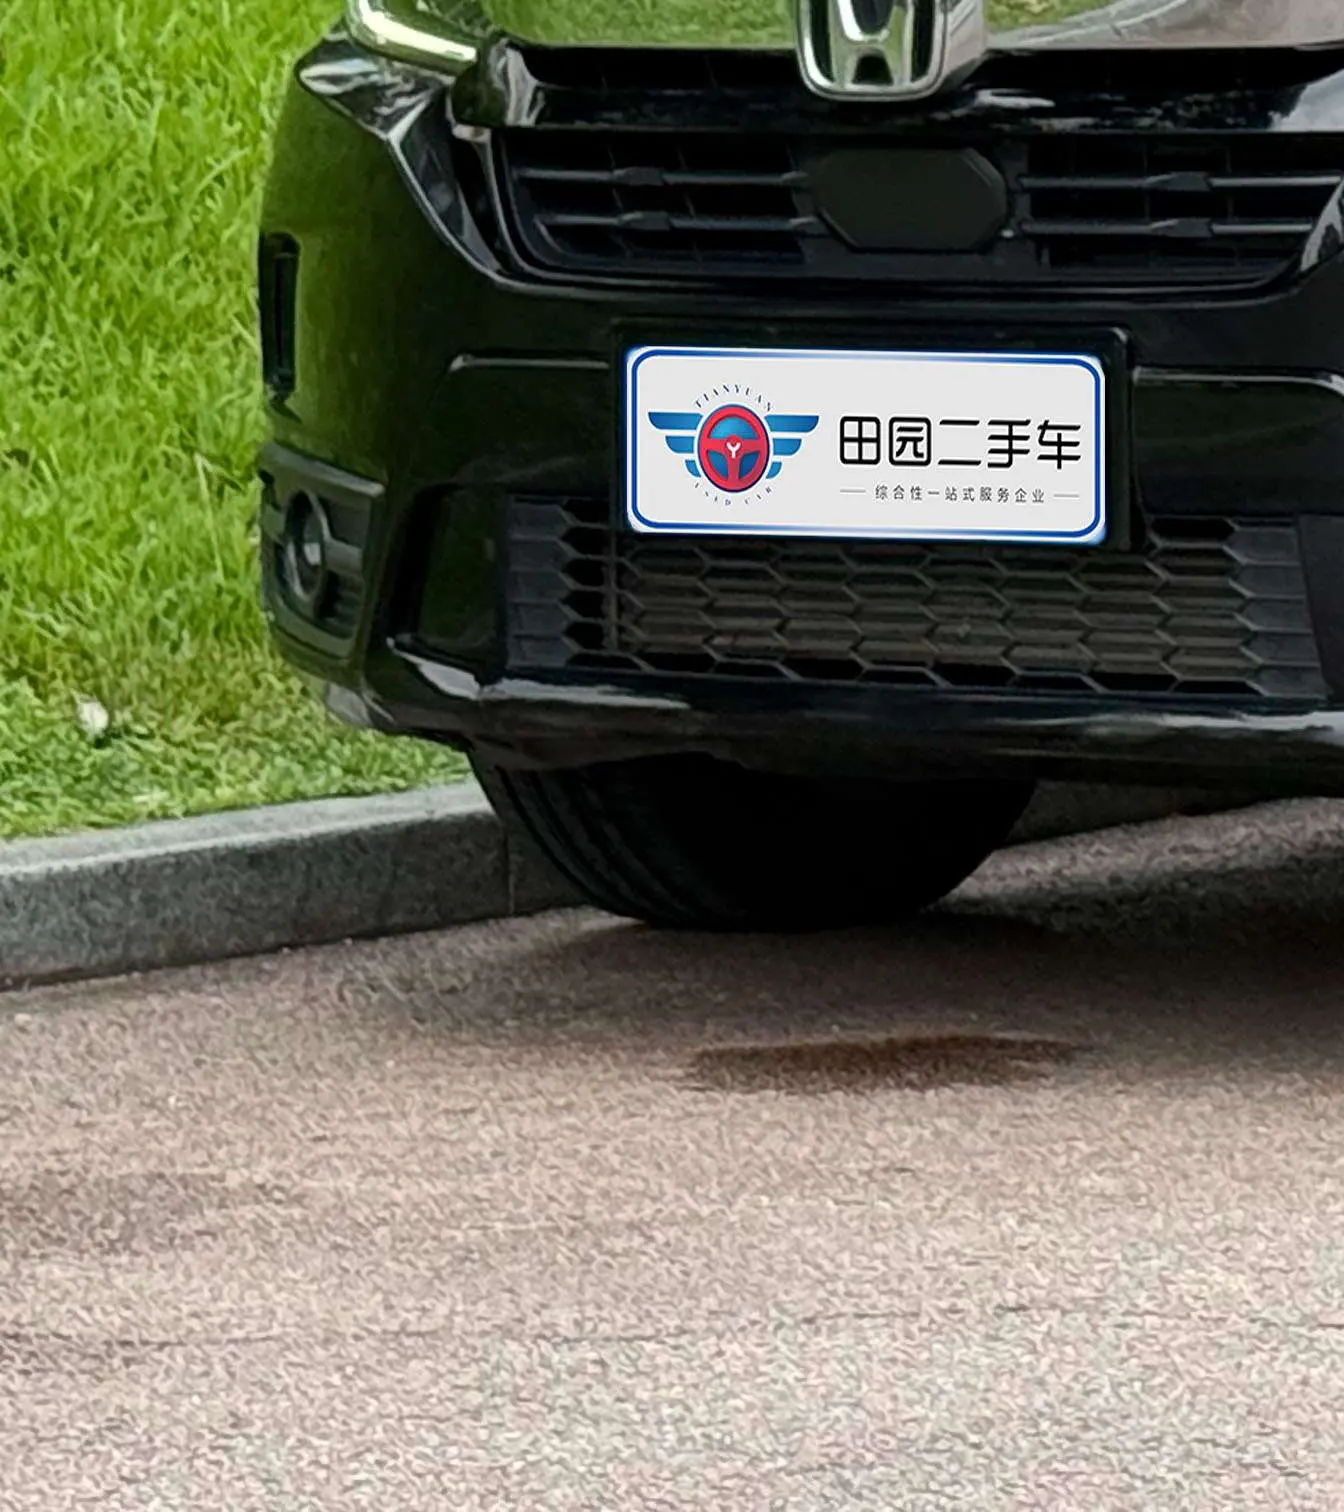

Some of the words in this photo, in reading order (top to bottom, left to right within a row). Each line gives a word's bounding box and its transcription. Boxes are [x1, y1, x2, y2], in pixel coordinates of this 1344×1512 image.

[839, 416, 1082, 470] 田园二手车
[874, 484, 1045, 504] 综合性一站式服务企业
